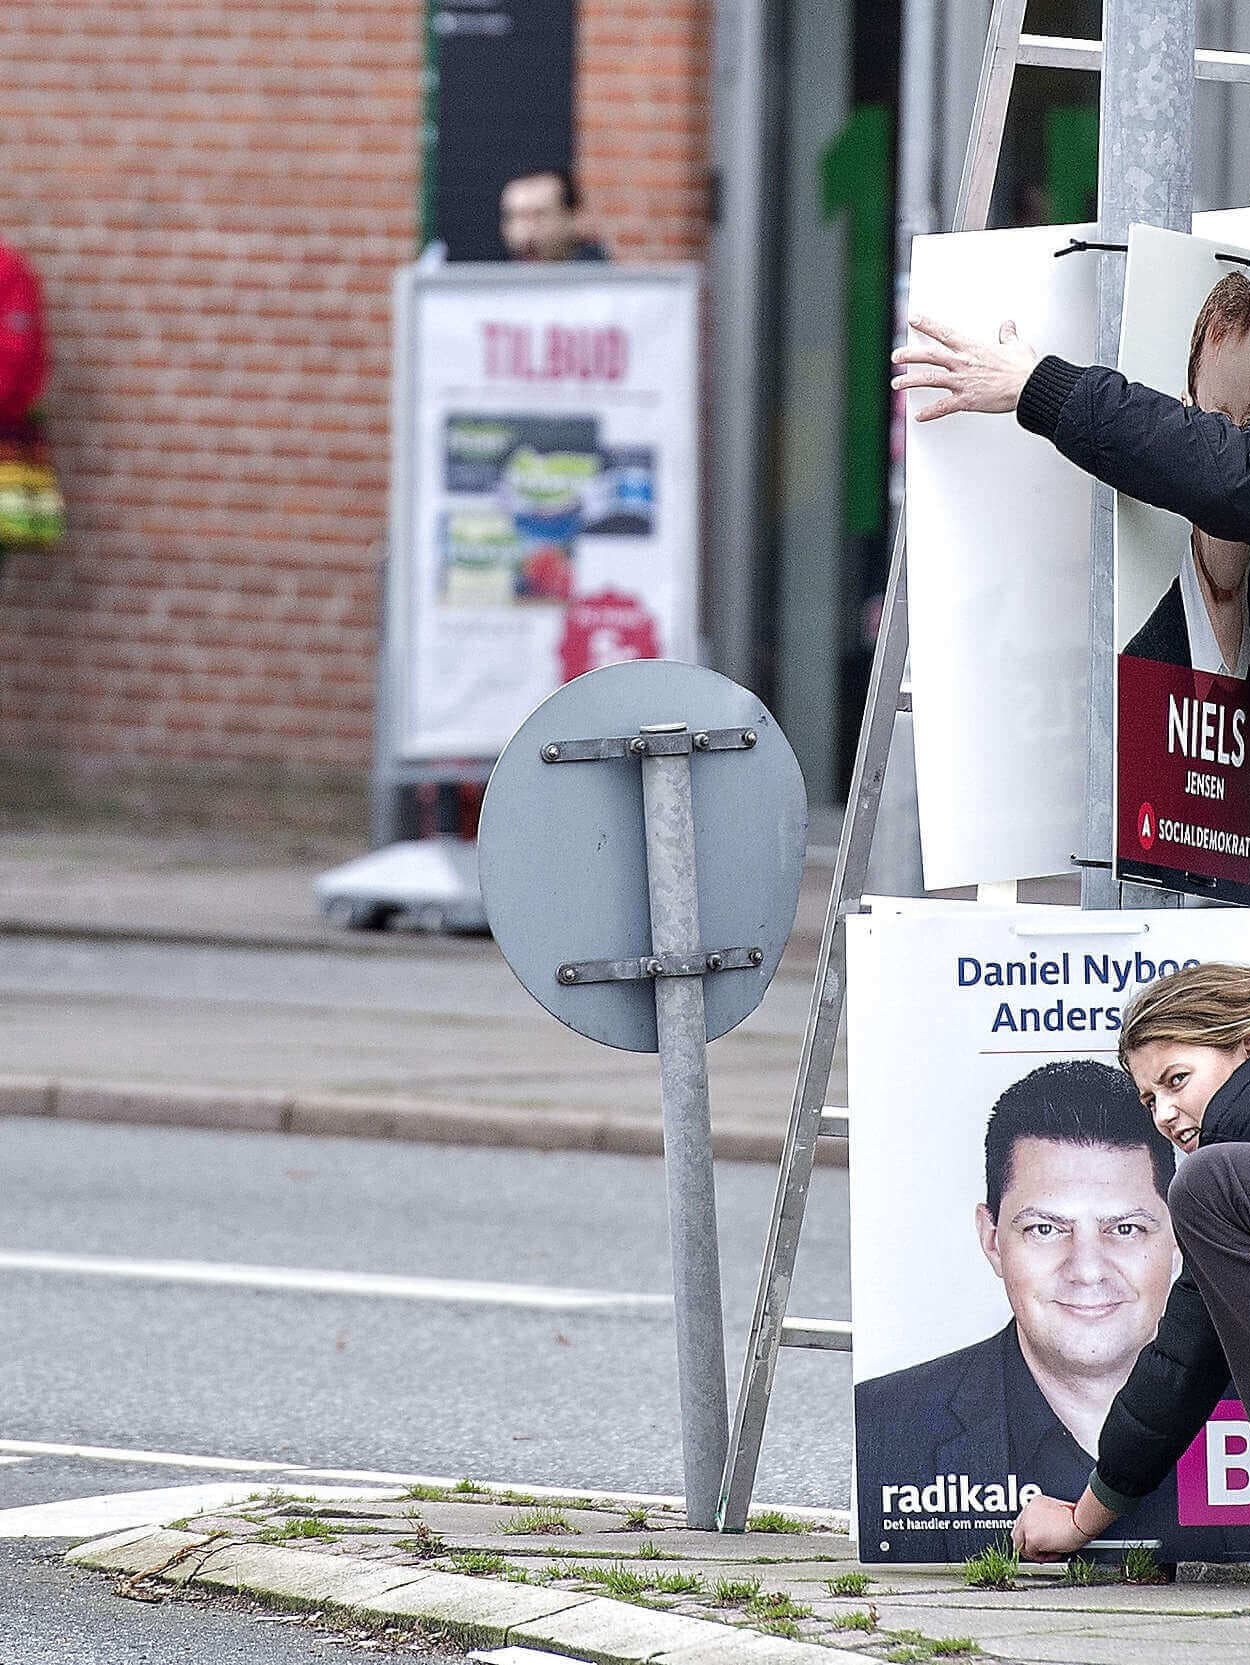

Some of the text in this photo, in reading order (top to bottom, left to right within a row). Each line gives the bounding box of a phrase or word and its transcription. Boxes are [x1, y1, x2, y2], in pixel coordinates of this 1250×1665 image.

[482, 319, 630, 381] TILBUD
[1168, 693, 1247, 768] NIELS
[1185, 770, 1225, 801] JENSEN
[1141, 812, 1151, 837] A
[958, 952, 1070, 987] Daniel
[991, 1000, 1122, 1032] Anders
[882, 1474, 1042, 1513] radikale
[883, 1518, 904, 1530] Det
[907, 1517, 950, 1530] handler
[952, 1519, 972, 1530] om
